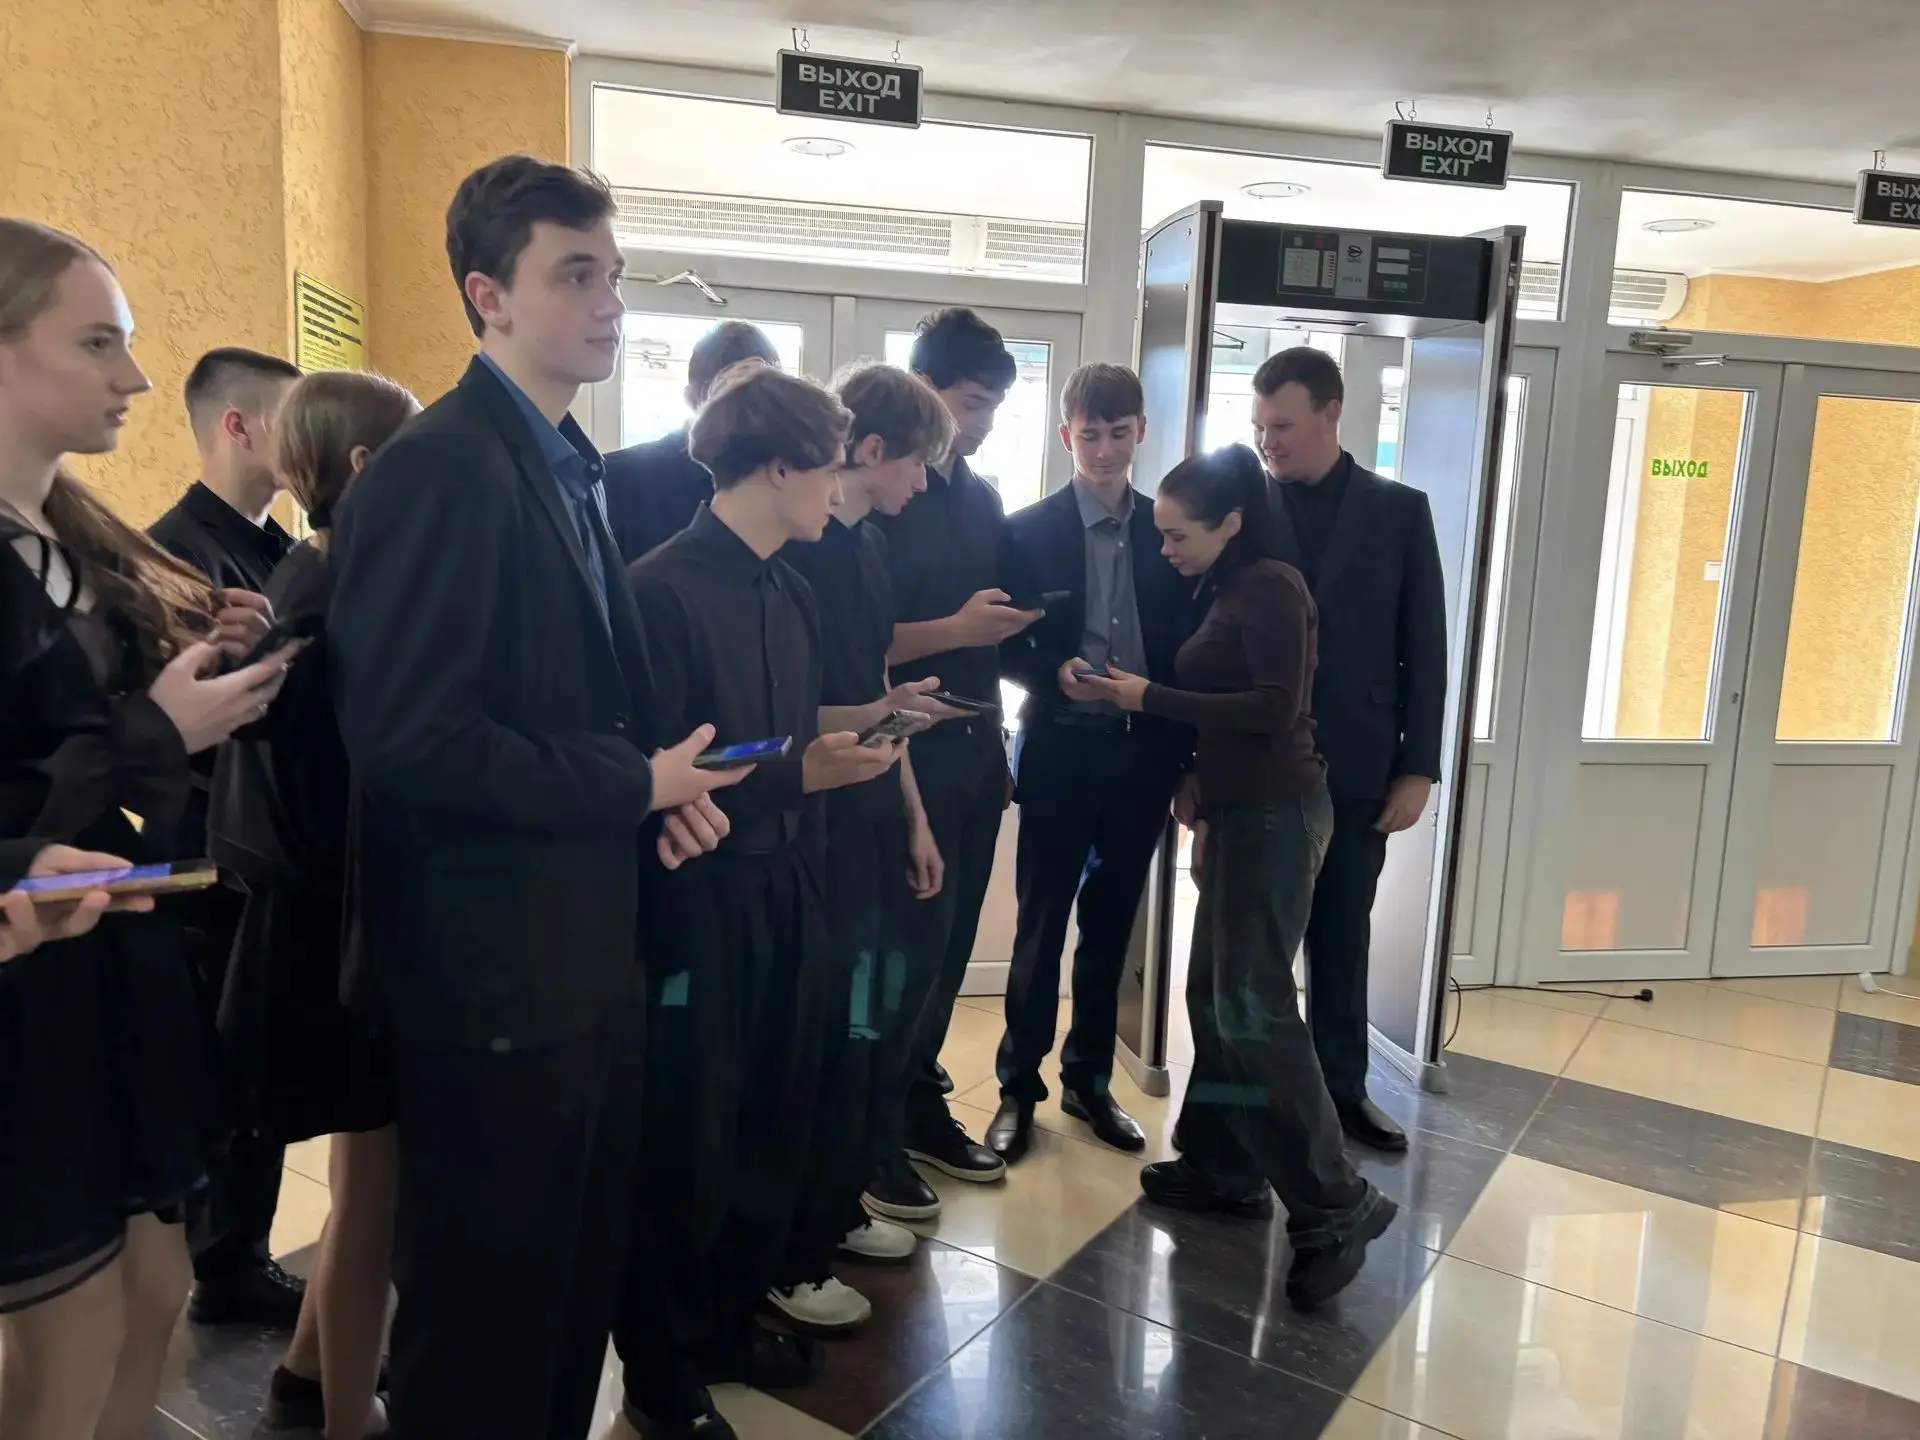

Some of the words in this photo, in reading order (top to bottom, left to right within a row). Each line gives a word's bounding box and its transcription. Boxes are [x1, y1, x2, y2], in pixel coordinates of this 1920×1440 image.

[798, 63, 901, 99] ВЫХОД
[818, 88, 881, 114] EXIT
[1405, 132, 1494, 163] ВЫХОД
[1420, 155, 1475, 177] EXIT
[1651, 459, 1709, 478] ВЫХОД
